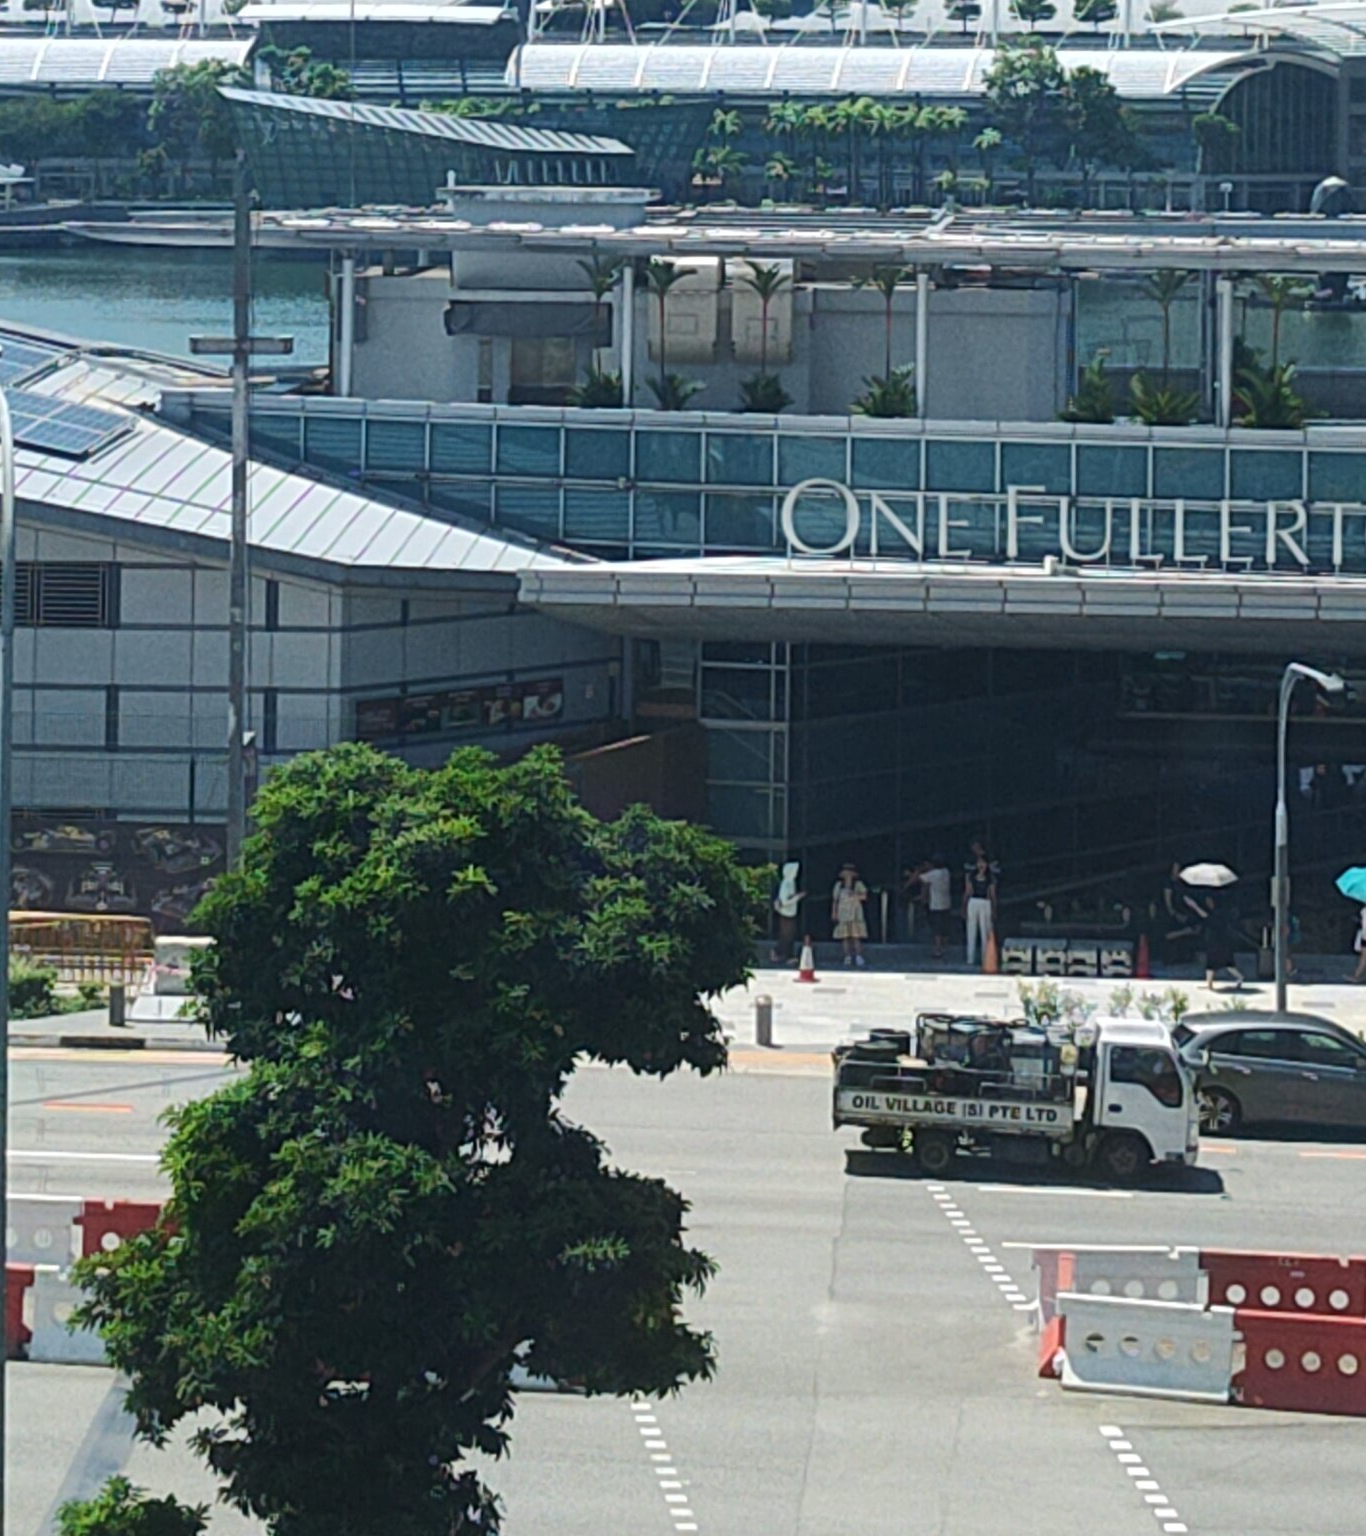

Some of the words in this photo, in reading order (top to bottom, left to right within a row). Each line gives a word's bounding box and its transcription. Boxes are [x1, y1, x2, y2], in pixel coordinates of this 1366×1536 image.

[782, 477, 972, 557] ONE
[852, 1095, 880, 1110] OIL
[885, 1097, 956, 1115] VILLAGE
[988, 1105, 1021, 1119] PTE
[1026, 1107, 1058, 1122] LTD
